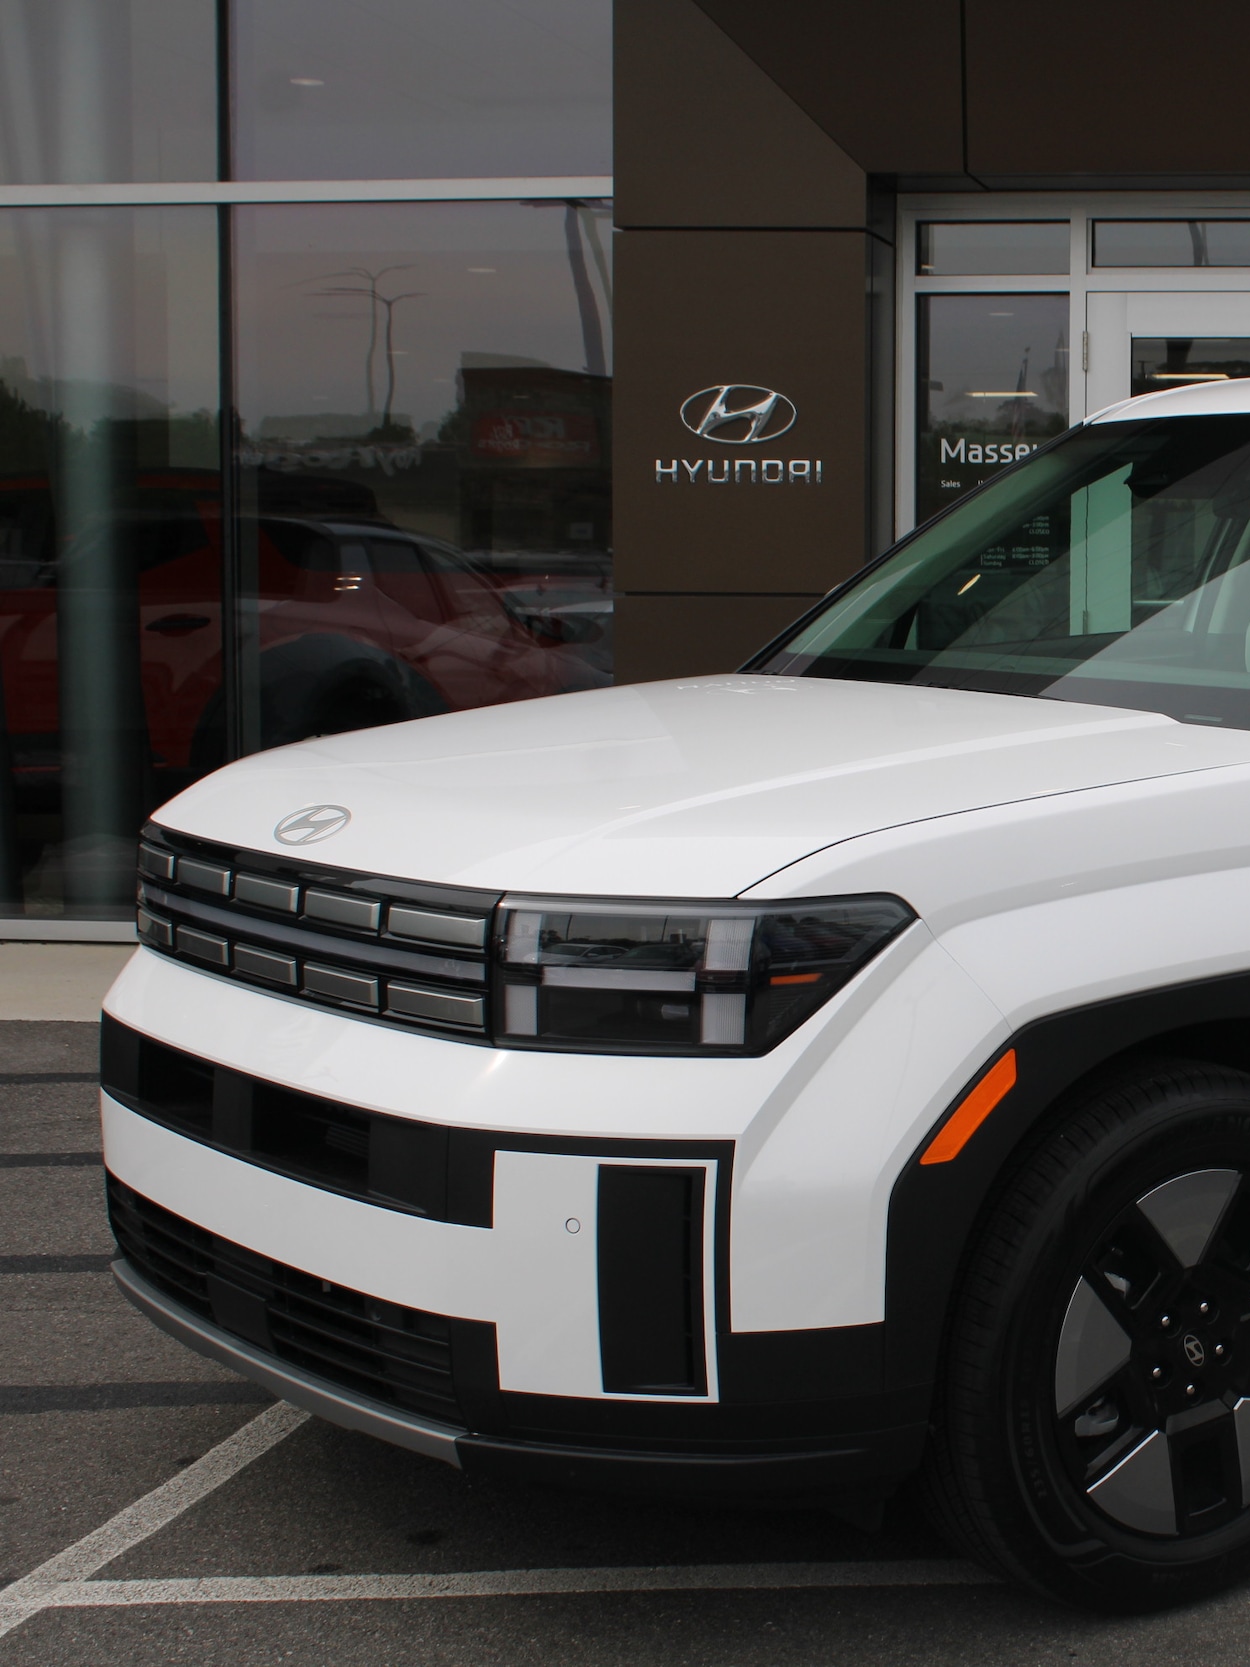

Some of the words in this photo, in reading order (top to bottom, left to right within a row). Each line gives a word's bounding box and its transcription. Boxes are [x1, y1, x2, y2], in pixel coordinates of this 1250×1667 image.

[940, 438, 1038, 464] Masse
[655, 459, 822, 484] HYUNDAI
[941, 479, 961, 488] Sales
